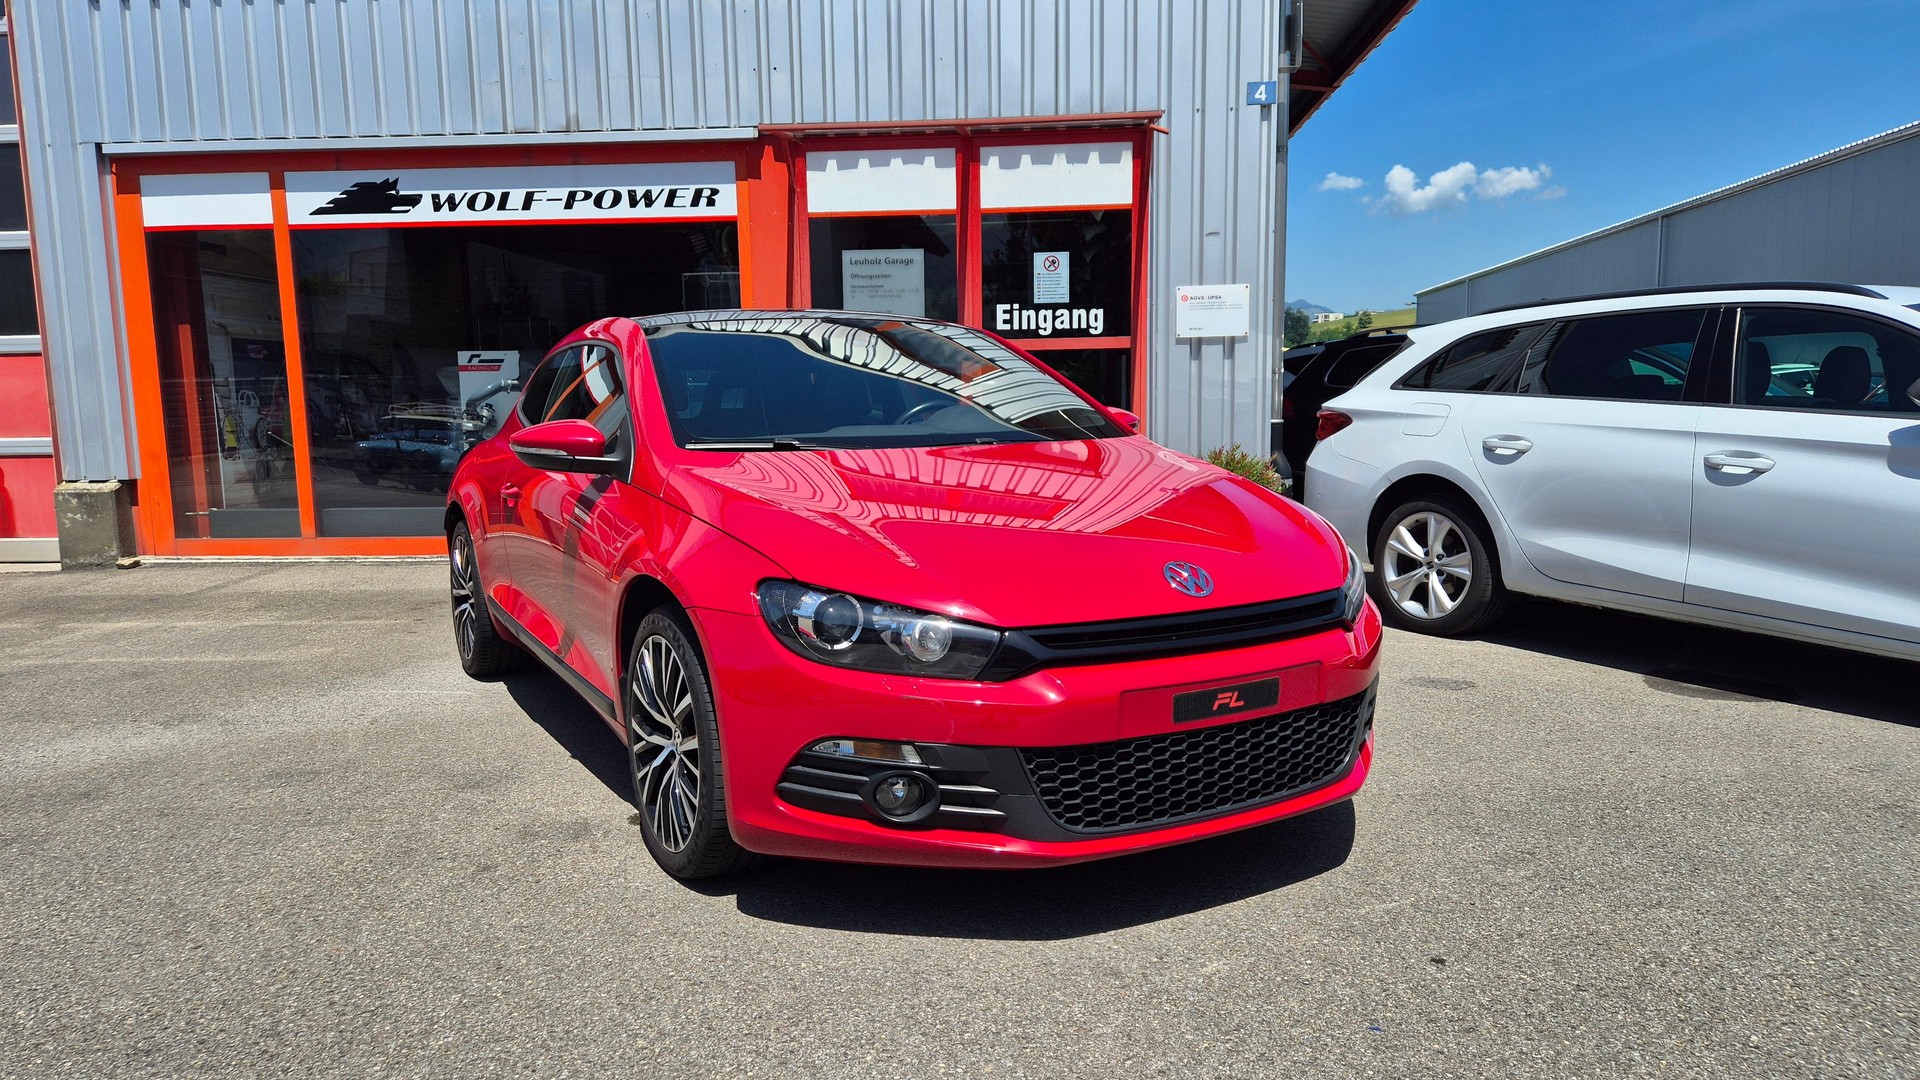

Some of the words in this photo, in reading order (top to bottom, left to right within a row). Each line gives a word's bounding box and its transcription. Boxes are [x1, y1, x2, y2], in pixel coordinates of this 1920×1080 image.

[1254, 84, 1267, 101] 4
[431, 187, 720, 213] WOLF-POWER
[849, 257, 882, 265] Leuholz
[884, 257, 914, 266] Garage
[996, 303, 1104, 335] Eingang
[1212, 691, 1244, 710] FL
